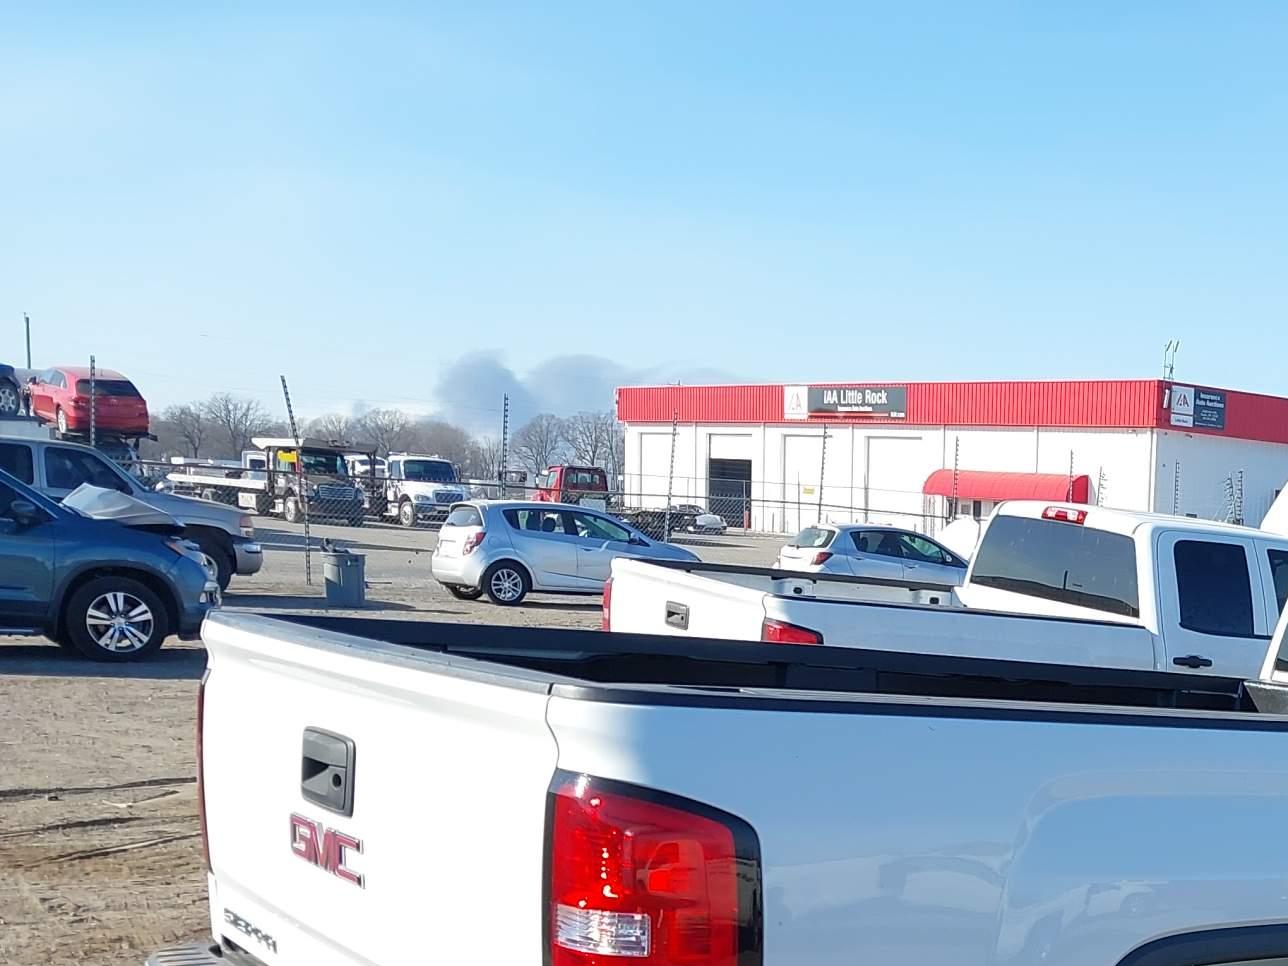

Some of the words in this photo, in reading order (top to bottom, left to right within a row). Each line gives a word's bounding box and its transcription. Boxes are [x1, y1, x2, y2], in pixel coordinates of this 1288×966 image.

[823, 389, 838, 404] IAA
[840, 389, 863, 404] Little
[865, 389, 888, 404] Rock
[290, 812, 365, 889] GMC
